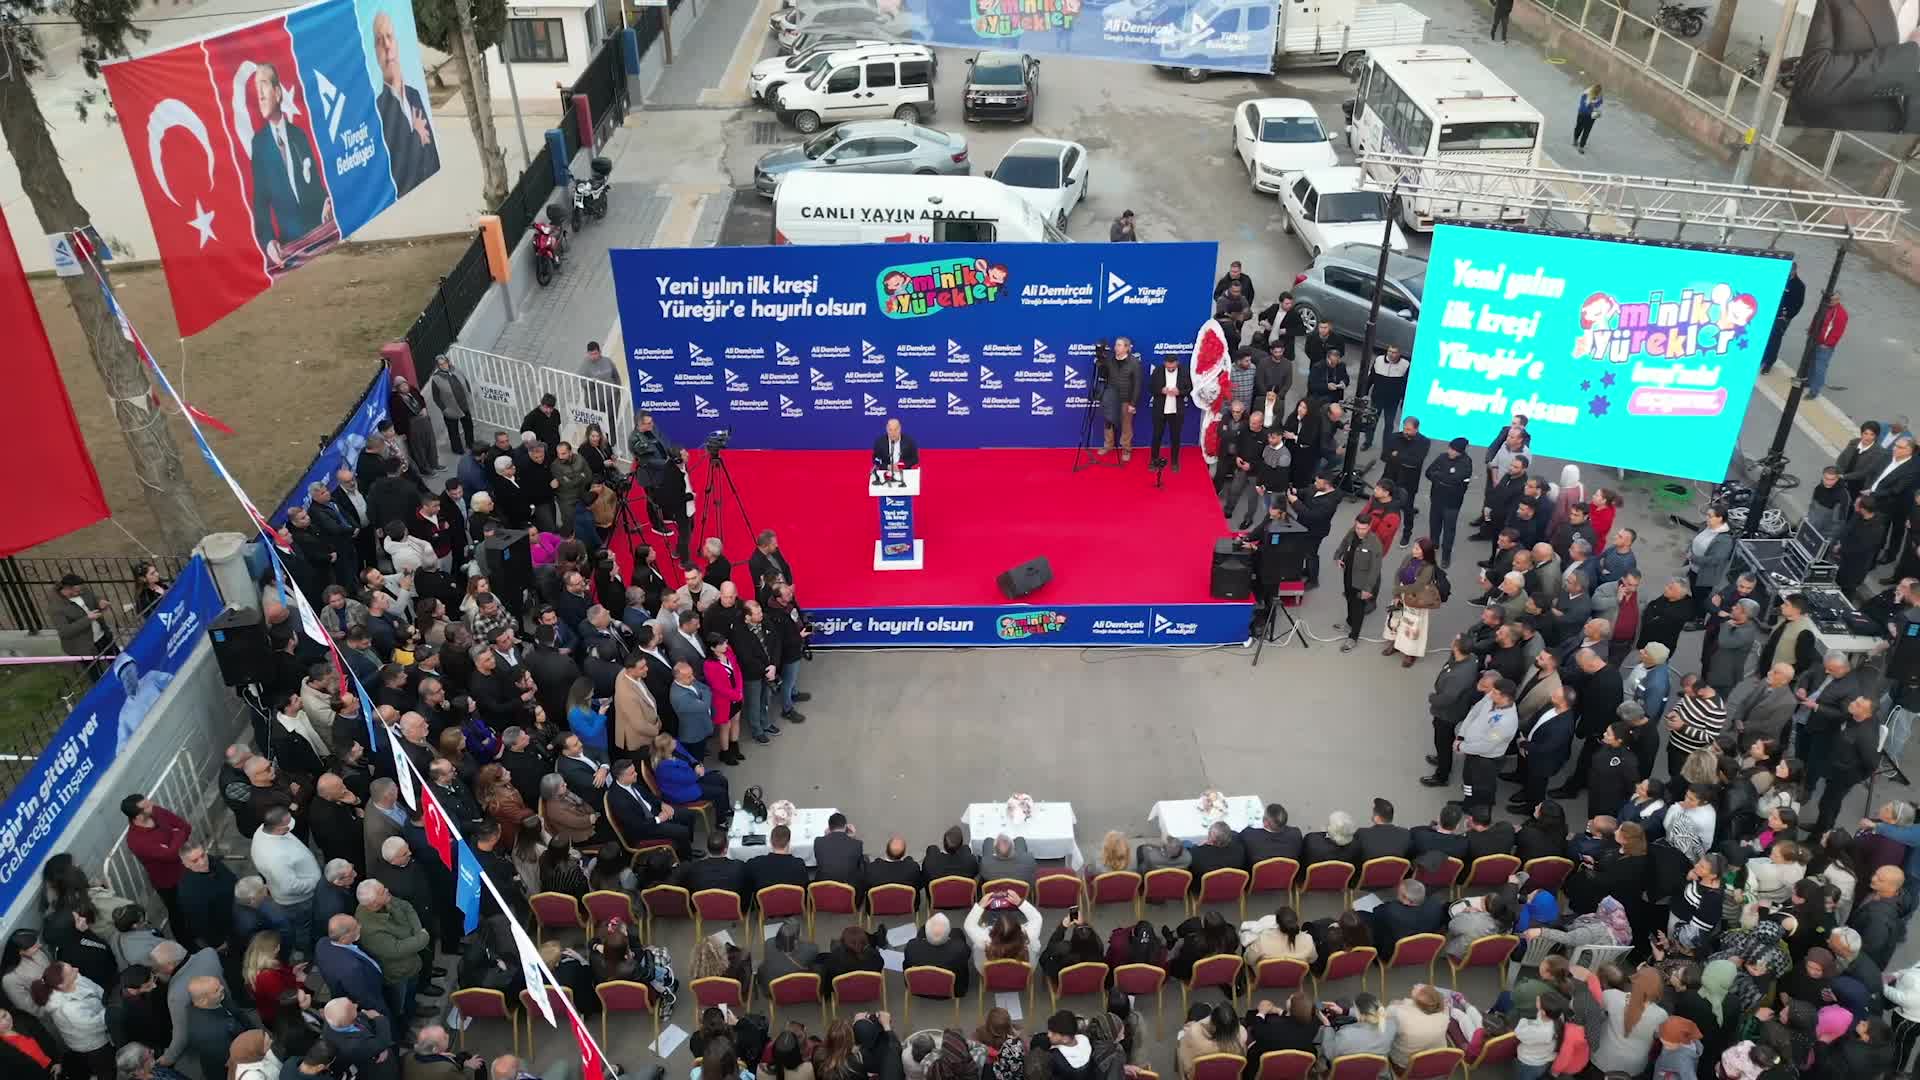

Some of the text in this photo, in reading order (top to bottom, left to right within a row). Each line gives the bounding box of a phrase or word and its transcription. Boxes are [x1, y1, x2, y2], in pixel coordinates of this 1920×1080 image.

[801, 206, 855, 219] CANLI
[860, 207, 915, 220] YAYIN
[656, 275, 818, 299] Yeni yılın ilk kreşi
[1453, 258, 1507, 291] Yeni
[1021, 283, 1093, 298] Ali Demirçalı
[1123, 295, 1164, 305] Belediyesi
[1138, 286, 1167, 297] Yüreğir
[659, 298, 866, 321] Yüreğir'e hayırlı olsun
[1619, 289, 1711, 327] minik
[1476, 303, 1542, 342] kreşi
[1592, 322, 1736, 363] yürekler
[1438, 341, 1545, 380] Yüreğir'e
[1511, 393, 1579, 425] olsun
[809, 616, 974, 636] eğir'e hayırlı olsun
[1093, 620, 1104, 629] Ali
[38, 736, 79, 802] gittiği
[77, 711, 100, 747] yer
[0, 756, 95, 884] Geleceğin inşası
